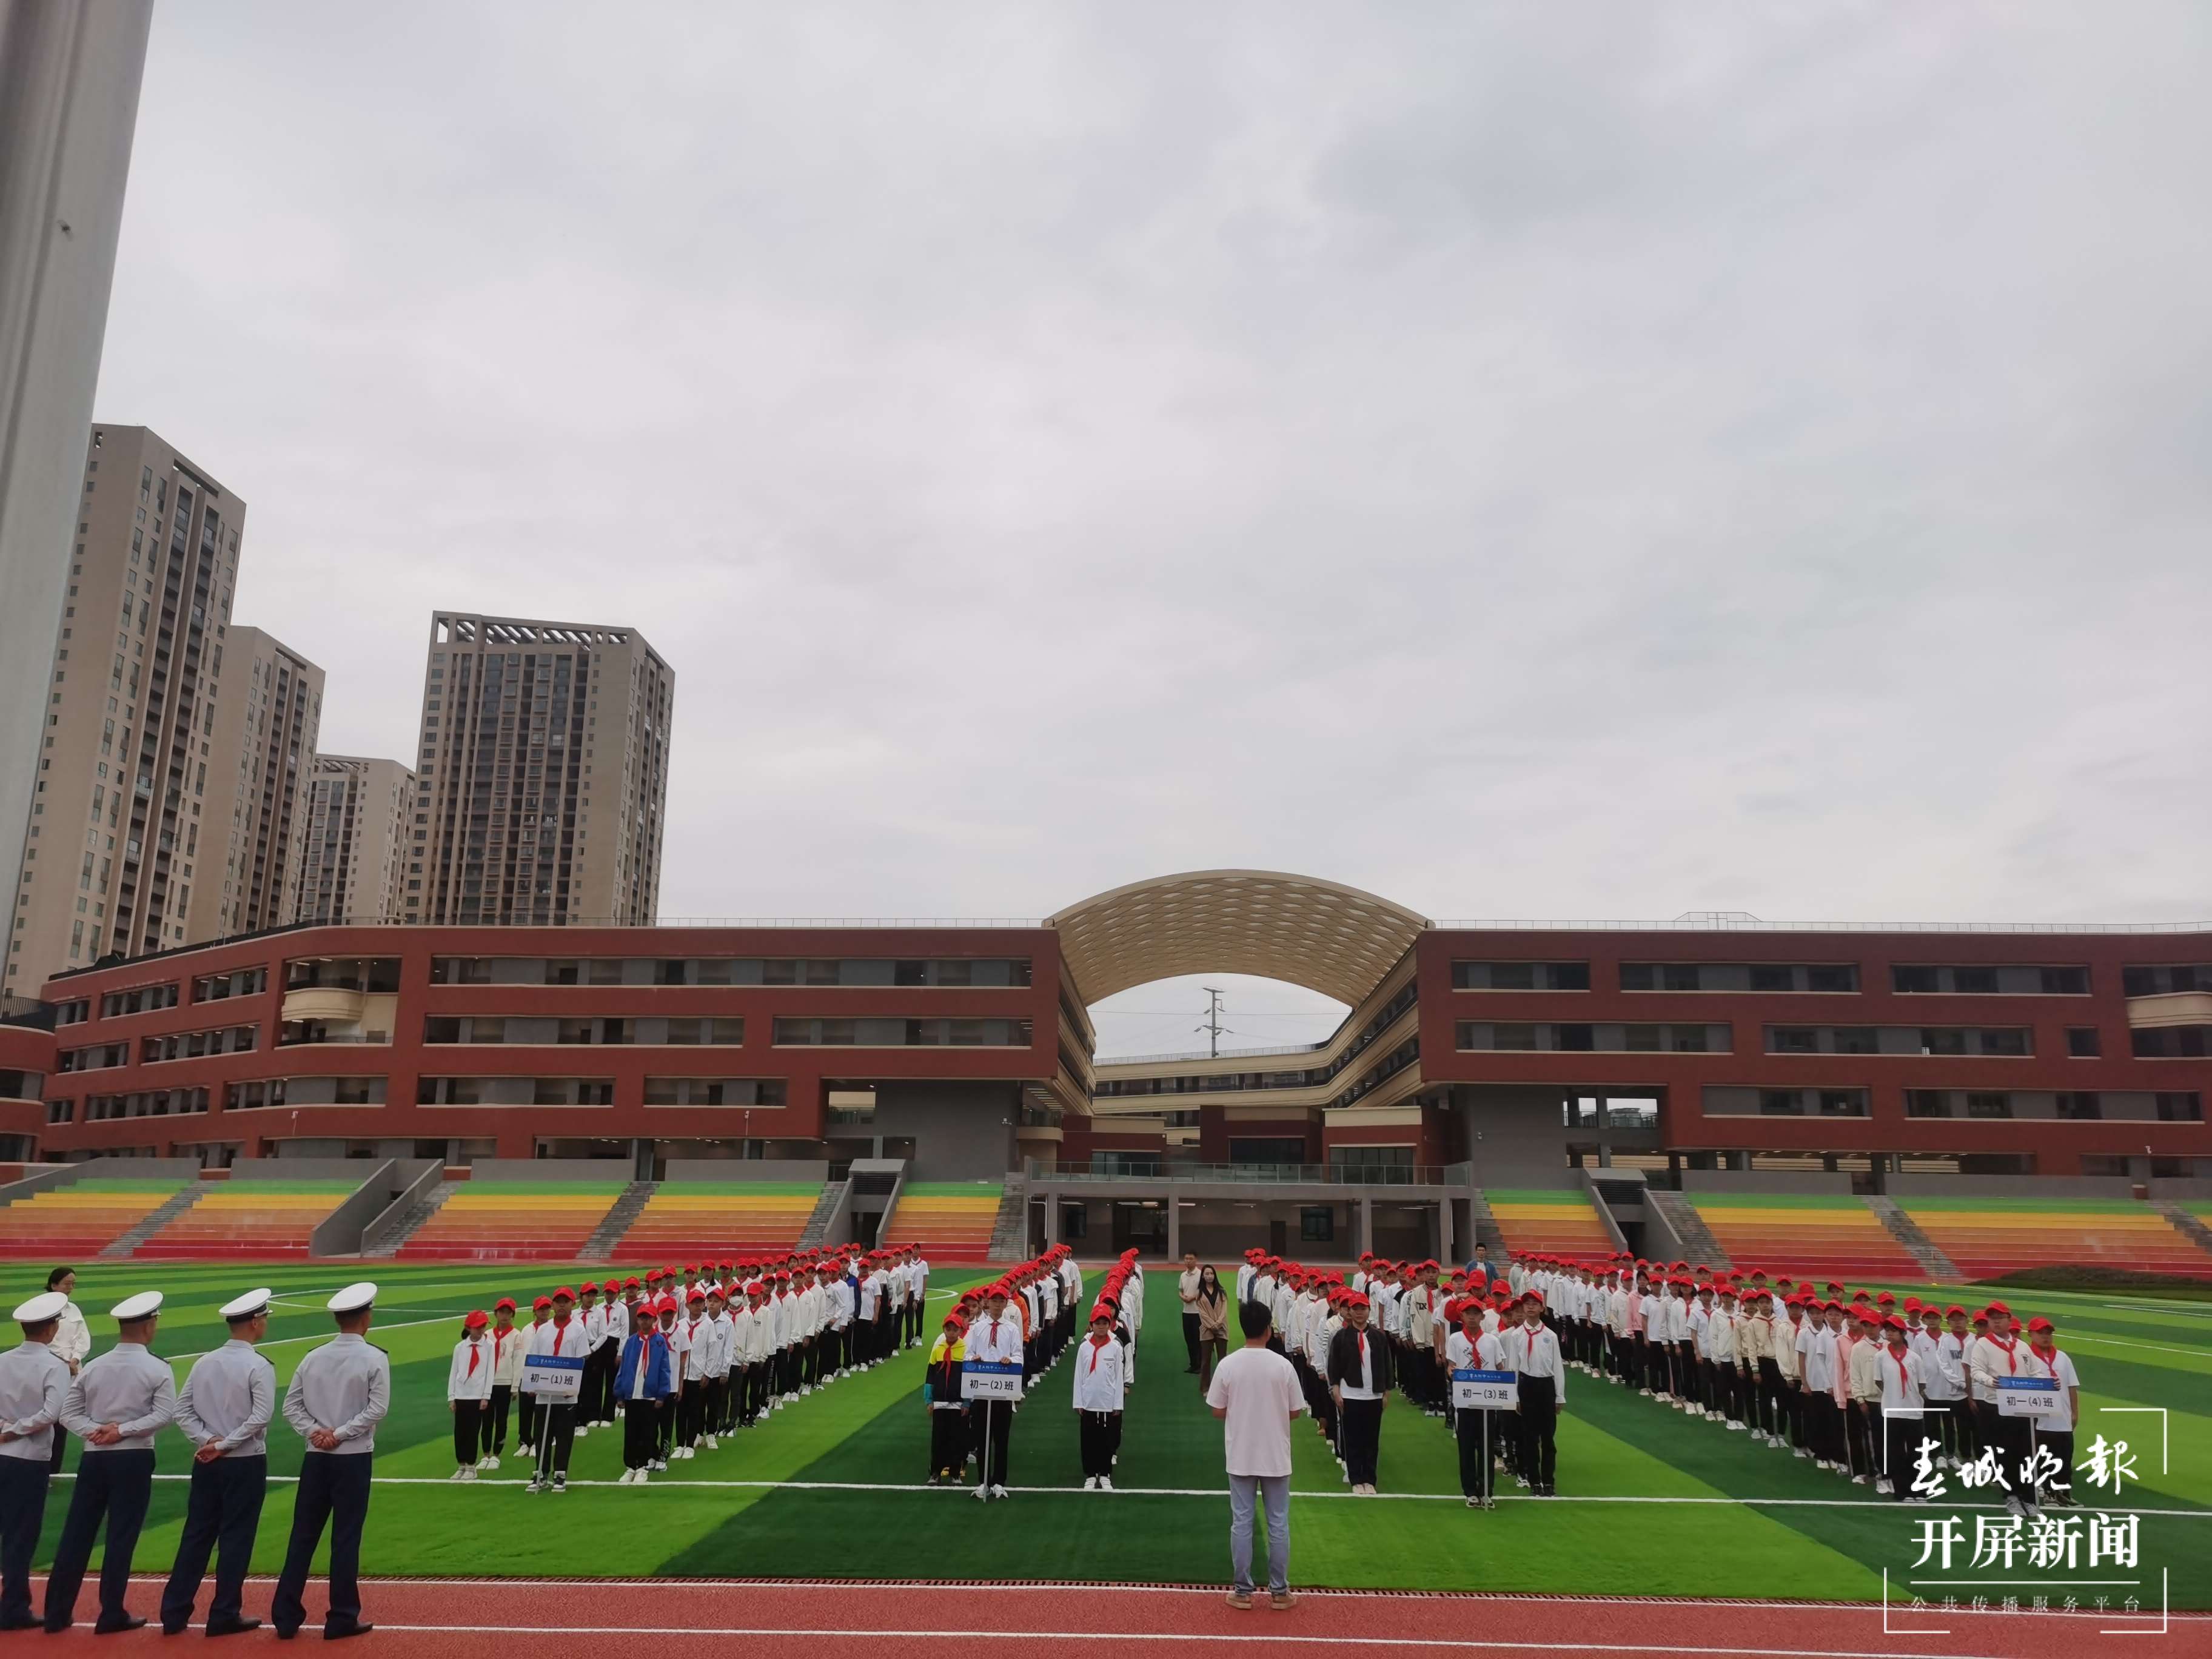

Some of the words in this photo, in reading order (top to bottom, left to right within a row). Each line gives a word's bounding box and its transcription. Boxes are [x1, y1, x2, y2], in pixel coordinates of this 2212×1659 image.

[970, 1379, 1014, 1390] 初一(2)班
[1462, 1388, 1509, 1399] 初一(3)班
[2006, 1396, 2054, 1407] 初一(4)班
